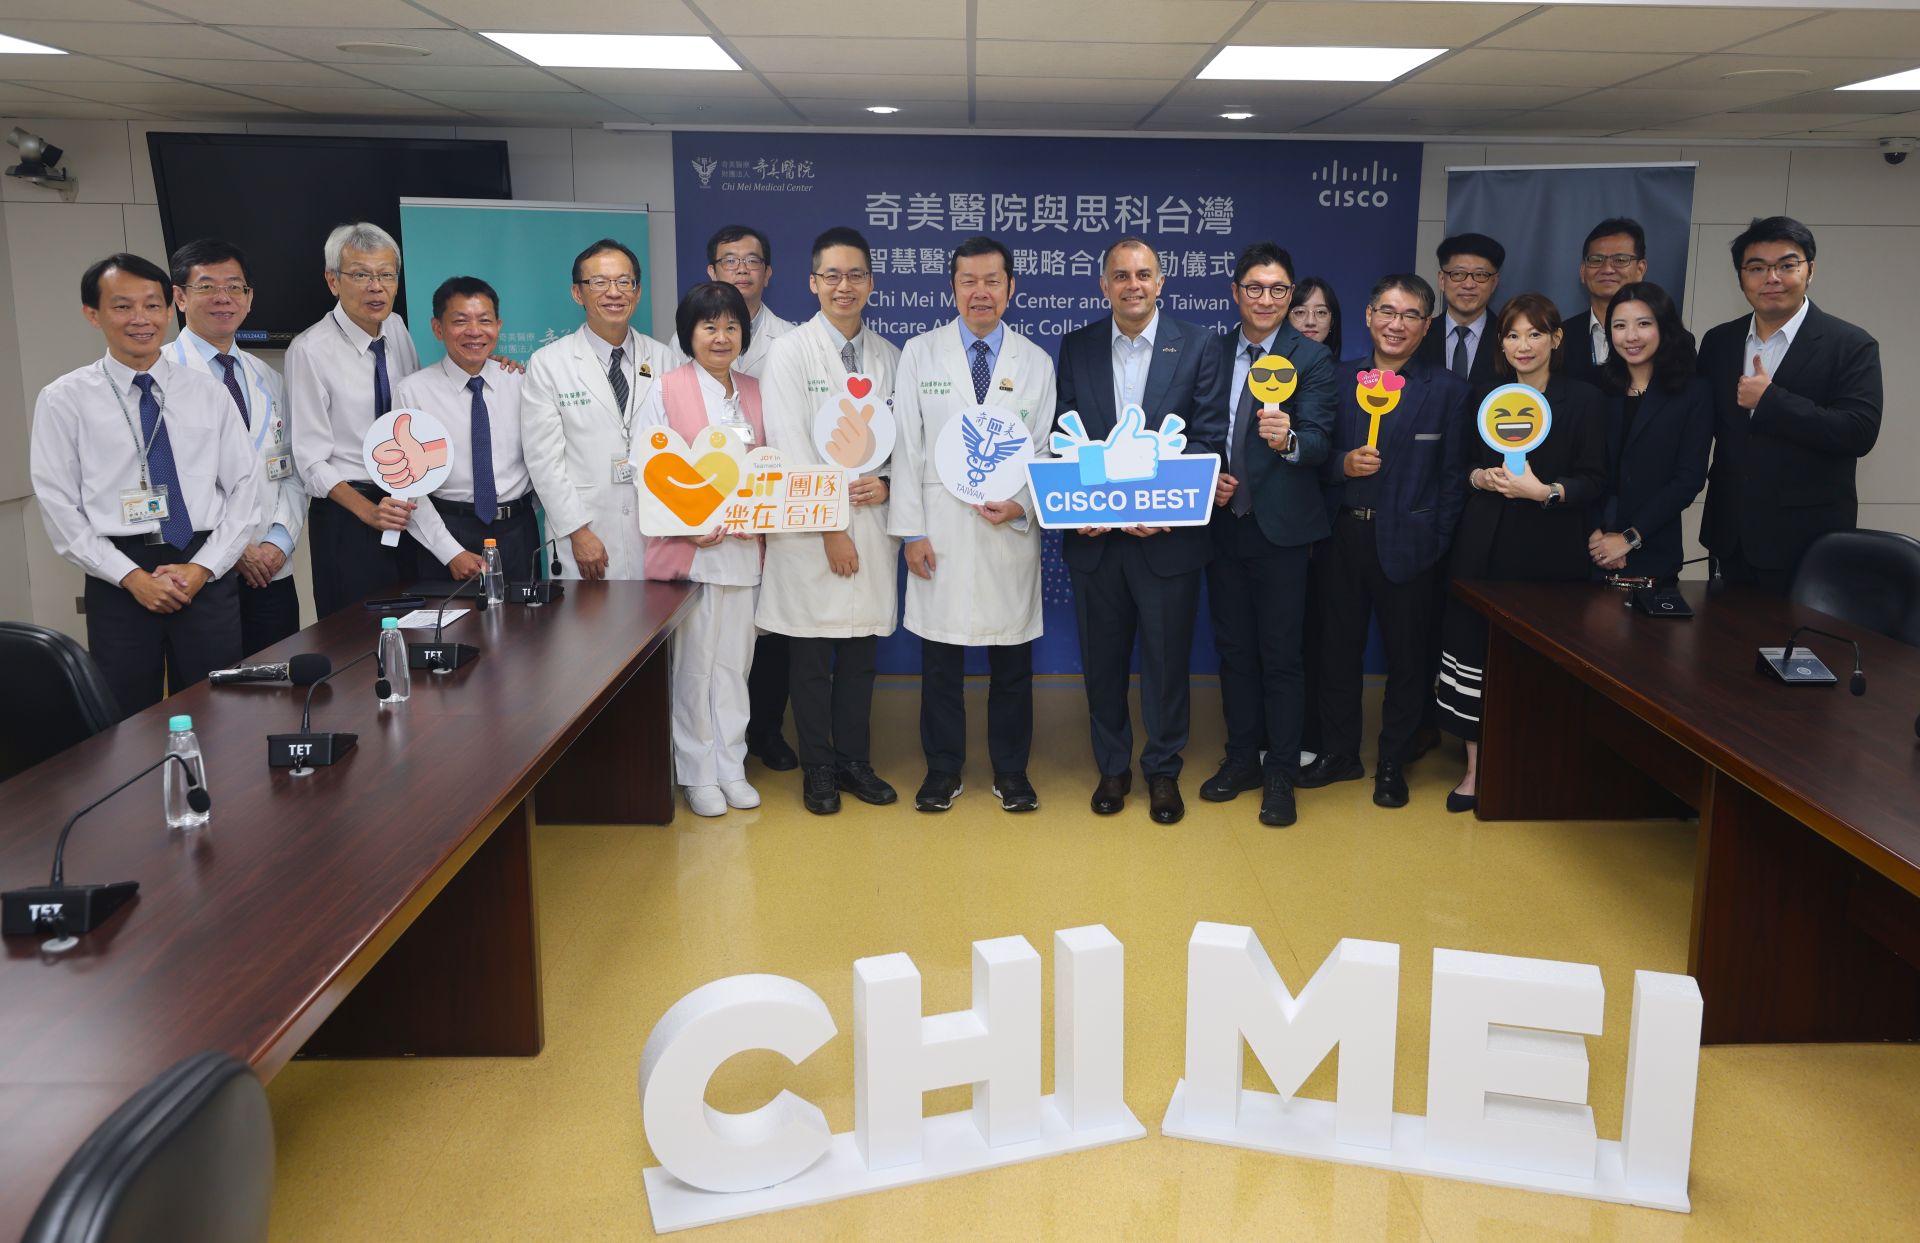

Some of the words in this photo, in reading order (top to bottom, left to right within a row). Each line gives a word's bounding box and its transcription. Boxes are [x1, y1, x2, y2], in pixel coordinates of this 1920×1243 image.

[753, 157, 815, 180] 奇美醫院
[722, 182, 735, 191] Chi
[737, 183, 752, 191] Mei
[753, 183, 785, 192] Medical
[786, 183, 813, 192] Center
[1318, 190, 1389, 207] CISCO
[865, 192, 1234, 234] 奇美醫院與思科台灣
[868, 291, 895, 308] Chi
[901, 292, 934, 308] Mei
[1015, 293, 1071, 309] Center
[1079, 293, 1112, 309] and
[1169, 294, 1230, 311] Taiwan
[867, 317, 928, 334] lthcare
[789, 474, 837, 498] 團隊
[956, 483, 986, 501] TAIWAN
[1045, 490, 1127, 512] CISCO
[1134, 489, 1200, 510] BEST
[724, 502, 778, 531] 樂在
[288, 744, 312, 756] TET
[638, 923, 1126, 1193] CHI
[1184, 921, 1704, 1212] MEI
